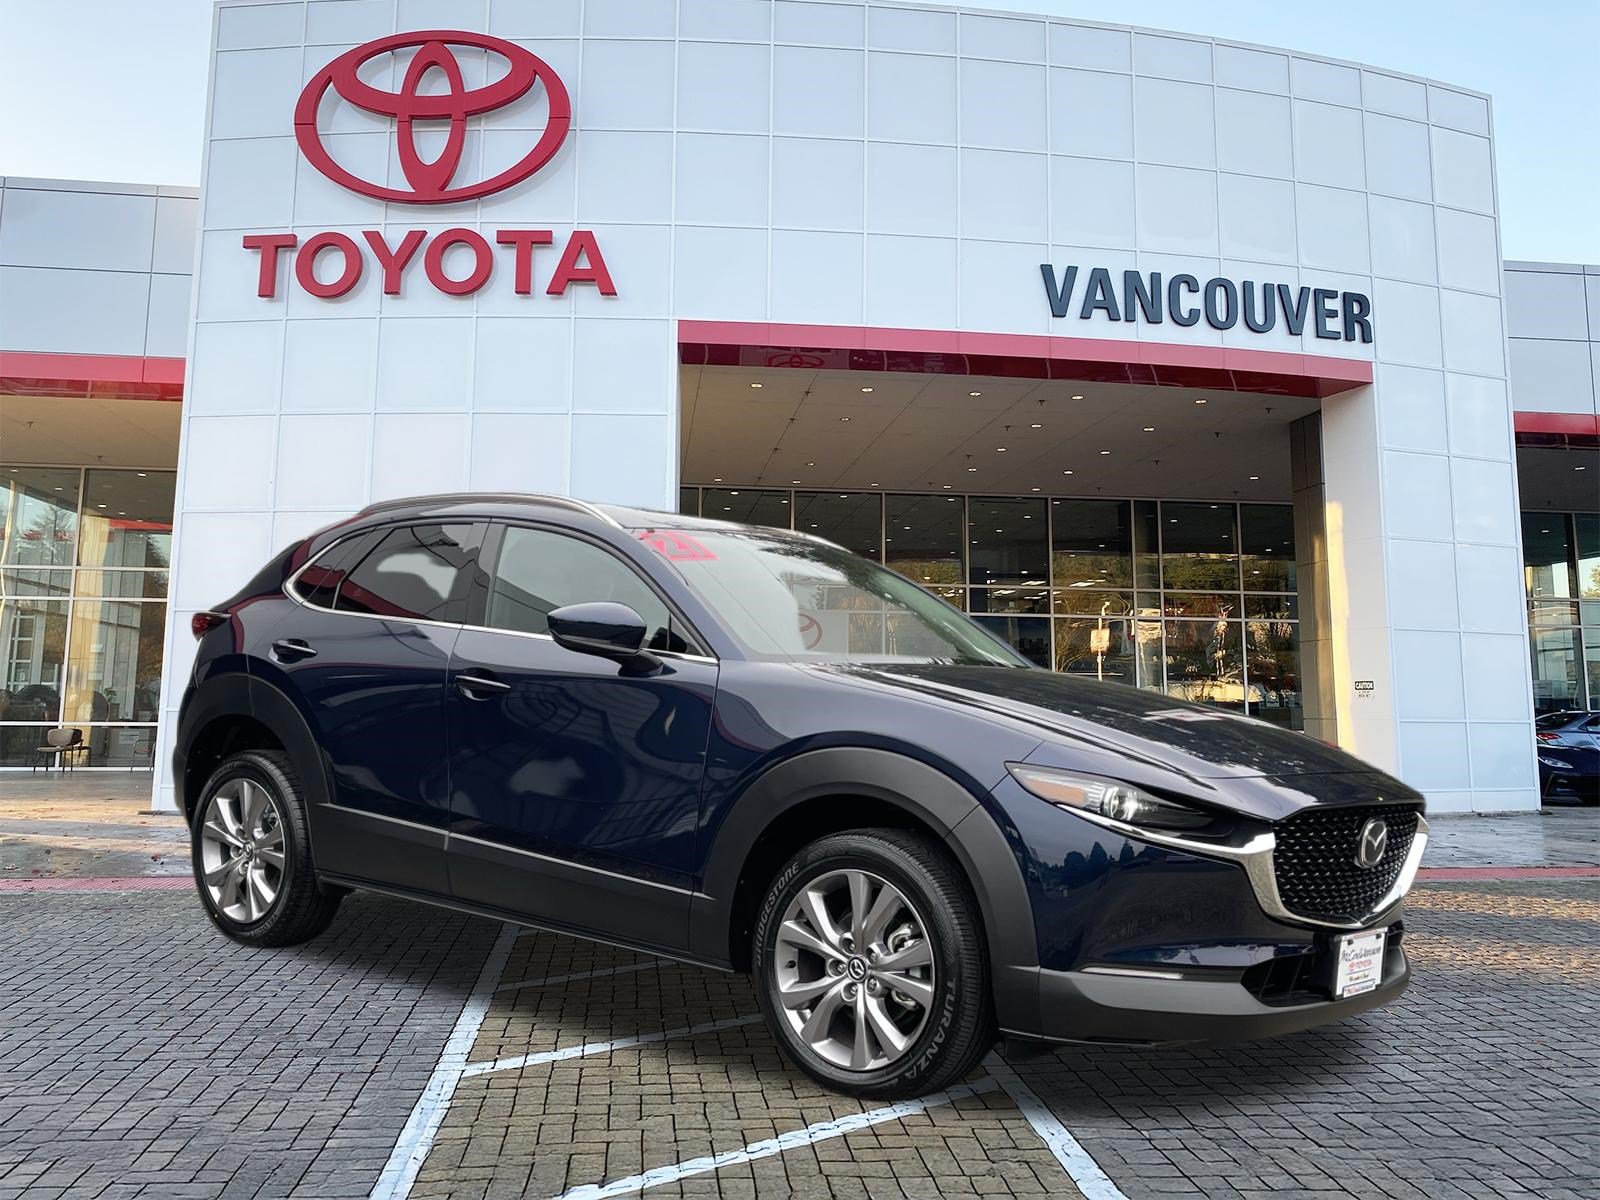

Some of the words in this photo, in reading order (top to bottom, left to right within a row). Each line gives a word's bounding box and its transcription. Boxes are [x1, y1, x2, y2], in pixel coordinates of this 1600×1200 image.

[243, 228, 617, 298] TOYOTA
[1040, 264, 1373, 344] VANCOUVER
[904, 978, 957, 1080] TURANZA
